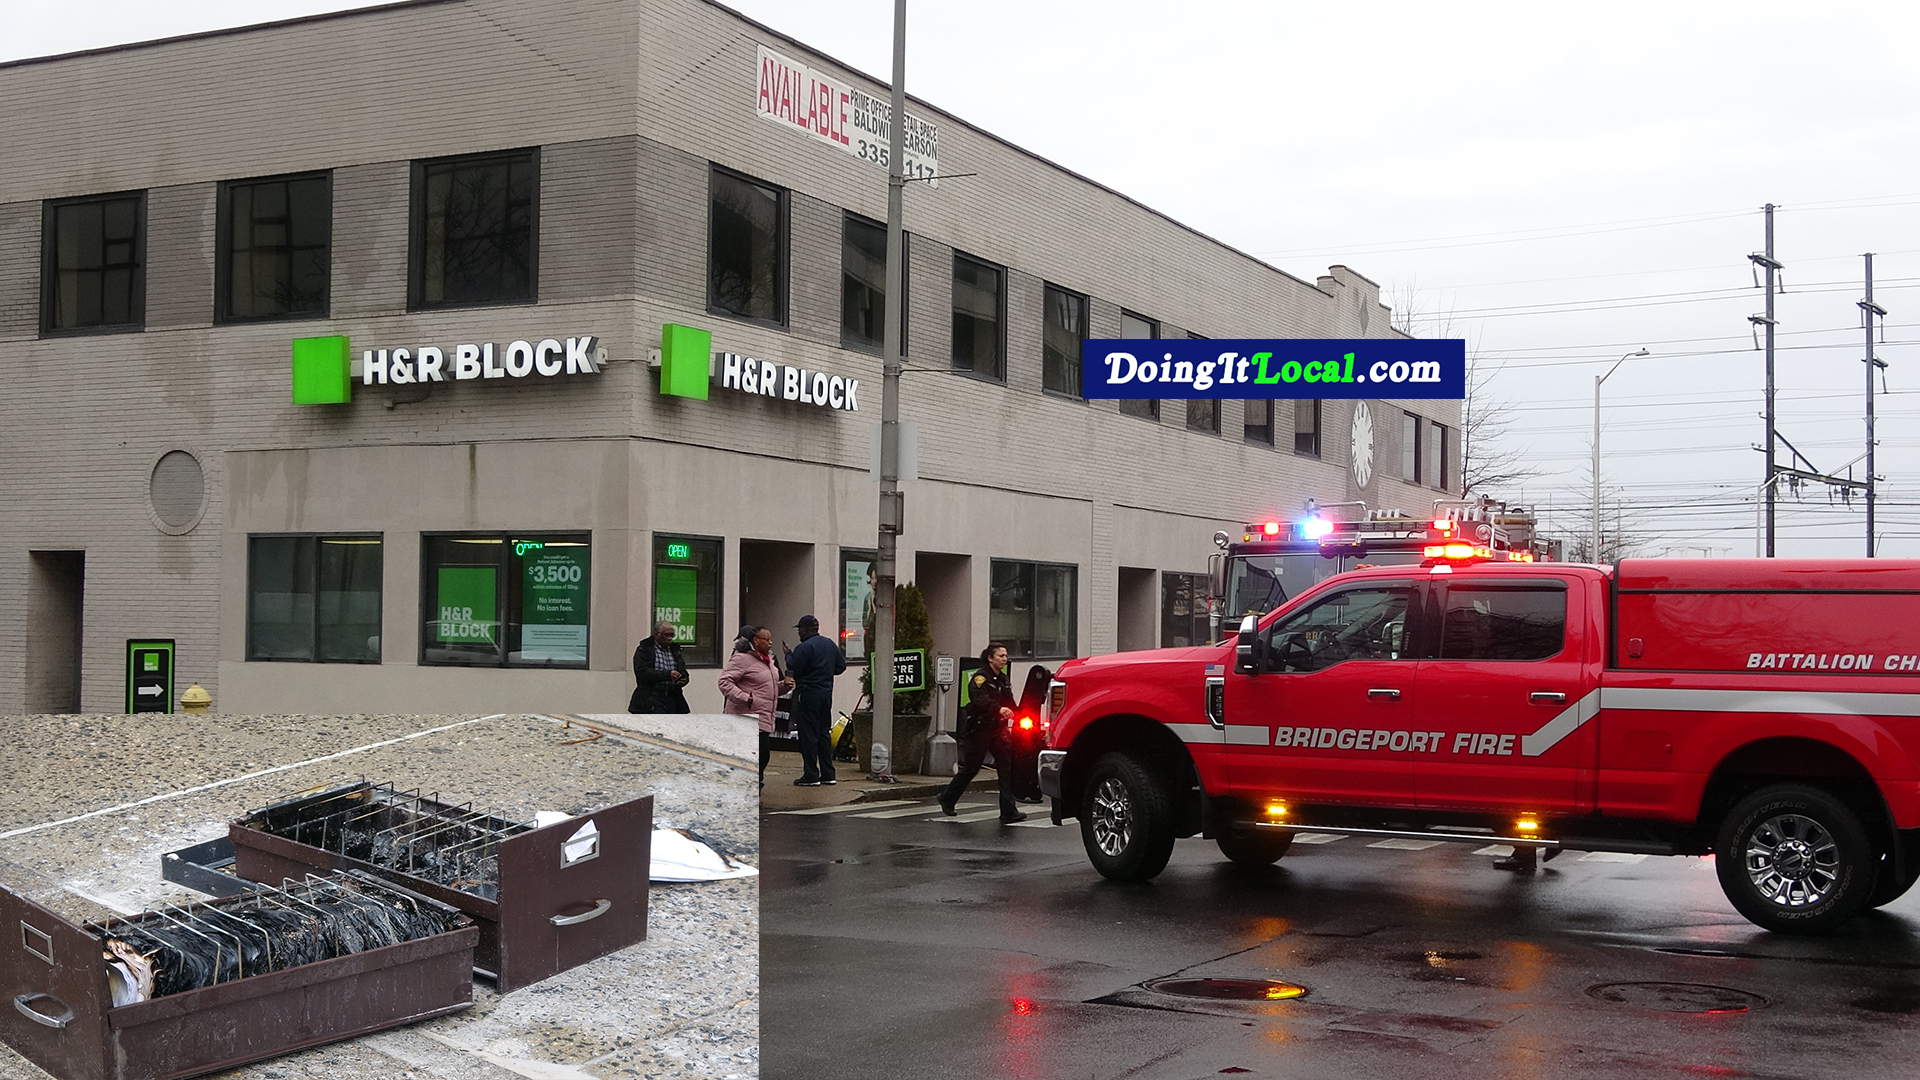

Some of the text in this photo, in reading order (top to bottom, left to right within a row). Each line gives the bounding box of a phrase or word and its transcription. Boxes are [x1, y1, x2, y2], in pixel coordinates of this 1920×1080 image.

[758, 57, 849, 146] AVAILABLE
[850, 89, 937, 143] PRIME OFFICE ETAIL SPACE
[854, 109, 938, 160] BALDWI EARSON
[362, 336, 597, 386] H&R BLOCK
[722, 352, 860, 411] H&R BLOCK
[667, 544, 688, 558] OPEN
[528, 565, 582, 584] $3,500
[441, 606, 472, 622] H&R
[656, 607, 681, 623] H&R
[440, 623, 491, 638] BLOCK
[893, 664, 914, 674] E'RE
[1746, 653, 1873, 670] BATTALION
[892, 674, 914, 684] PEN
[1274, 726, 1516, 756] BRIDGEPORT FIRE
